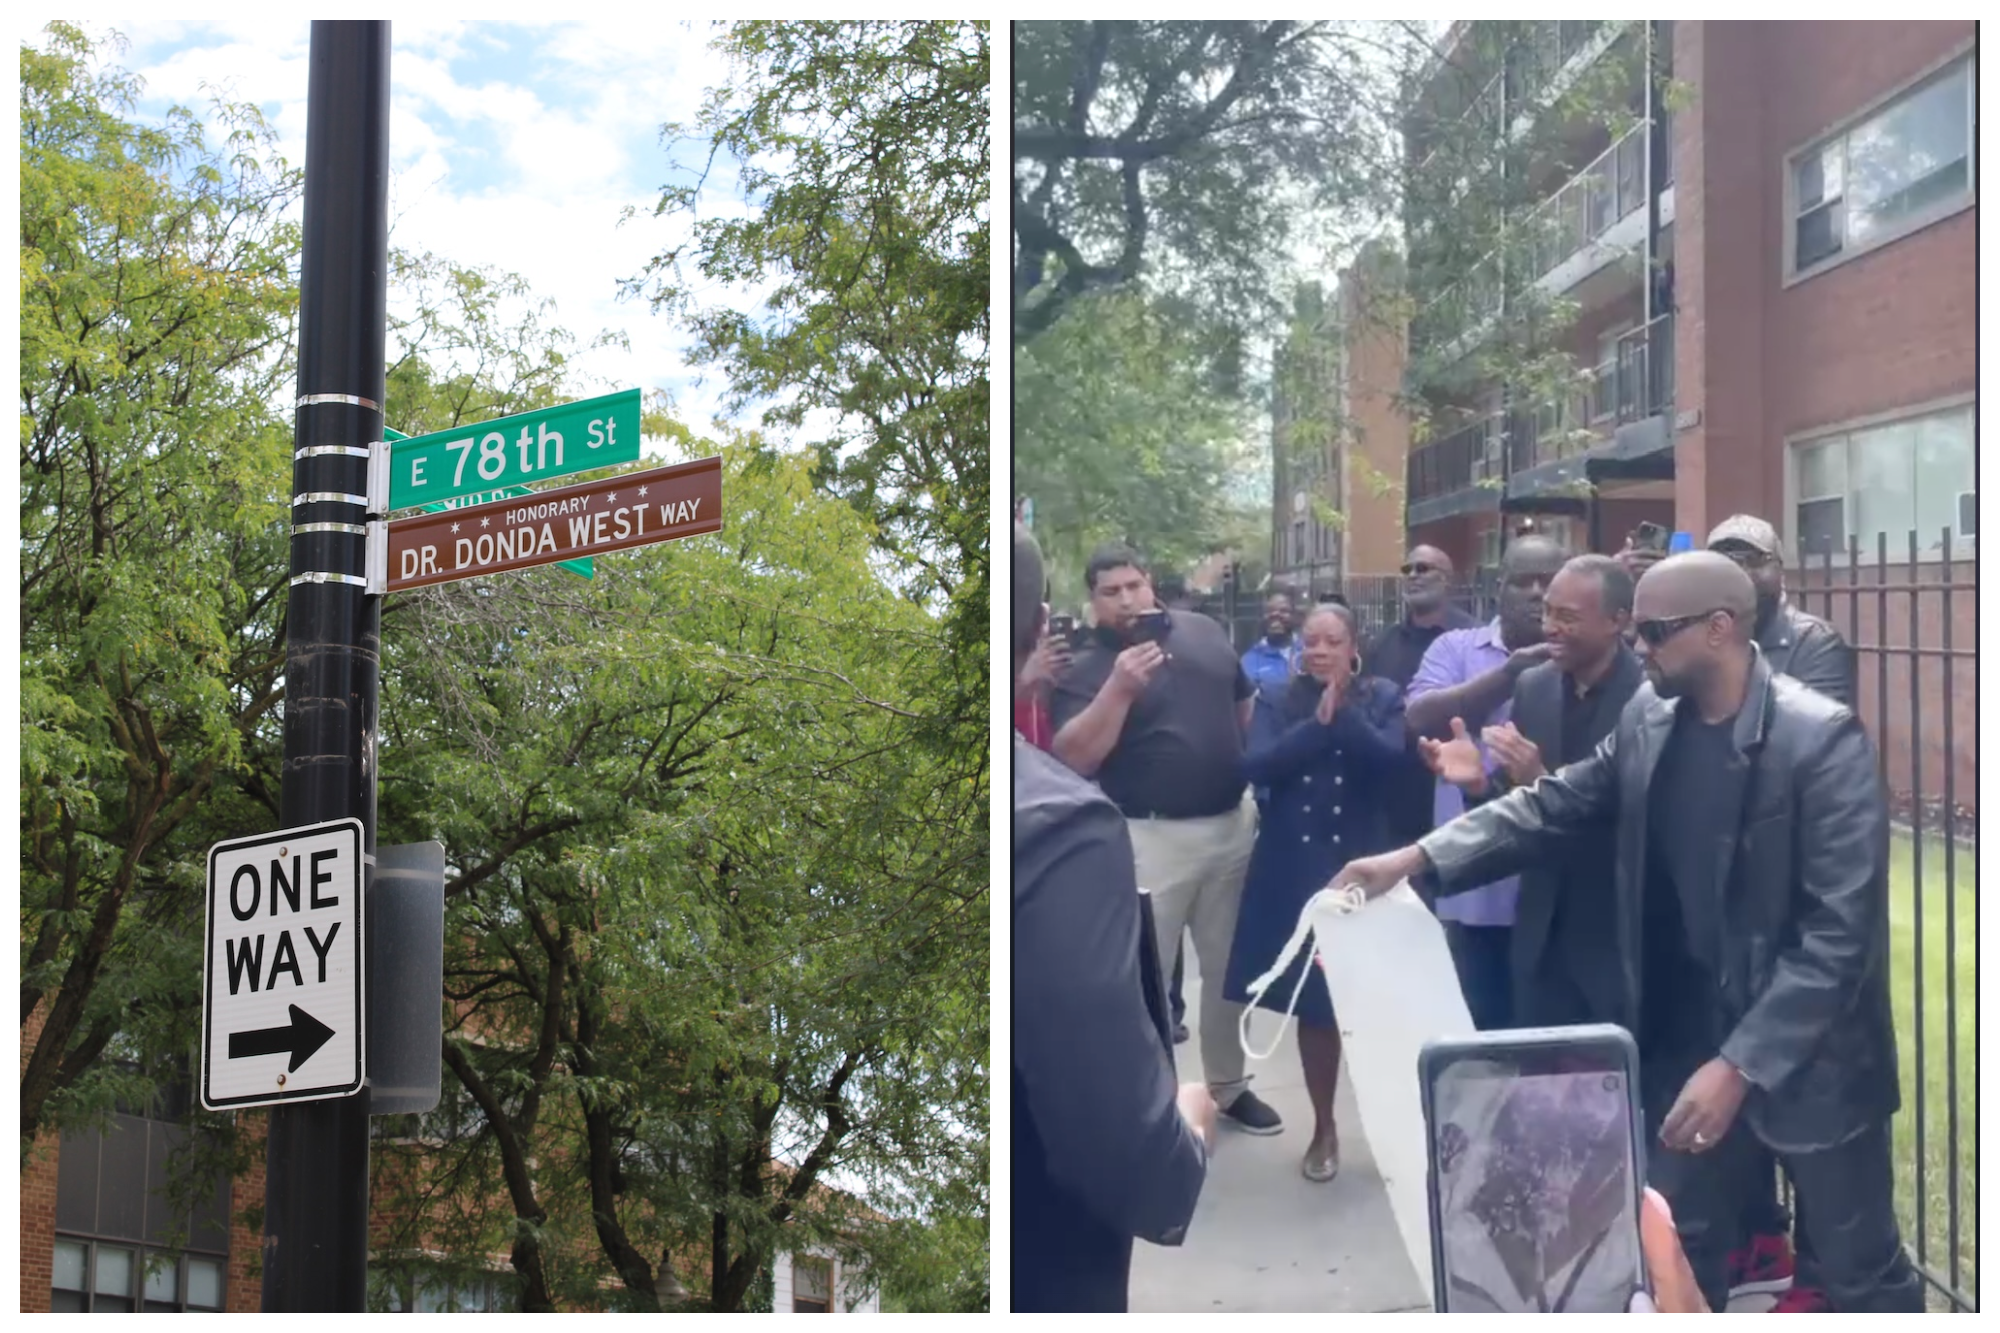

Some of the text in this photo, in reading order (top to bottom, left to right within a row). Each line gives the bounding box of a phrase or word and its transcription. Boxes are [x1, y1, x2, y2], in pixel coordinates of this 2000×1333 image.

[411, 416, 617, 487] E 78th St
[401, 498, 701, 580] DR. DONDA WEST WAY
[506, 495, 590, 526] HONORARY
[229, 848, 339, 921] ONE
[226, 922, 342, 995] WAY
